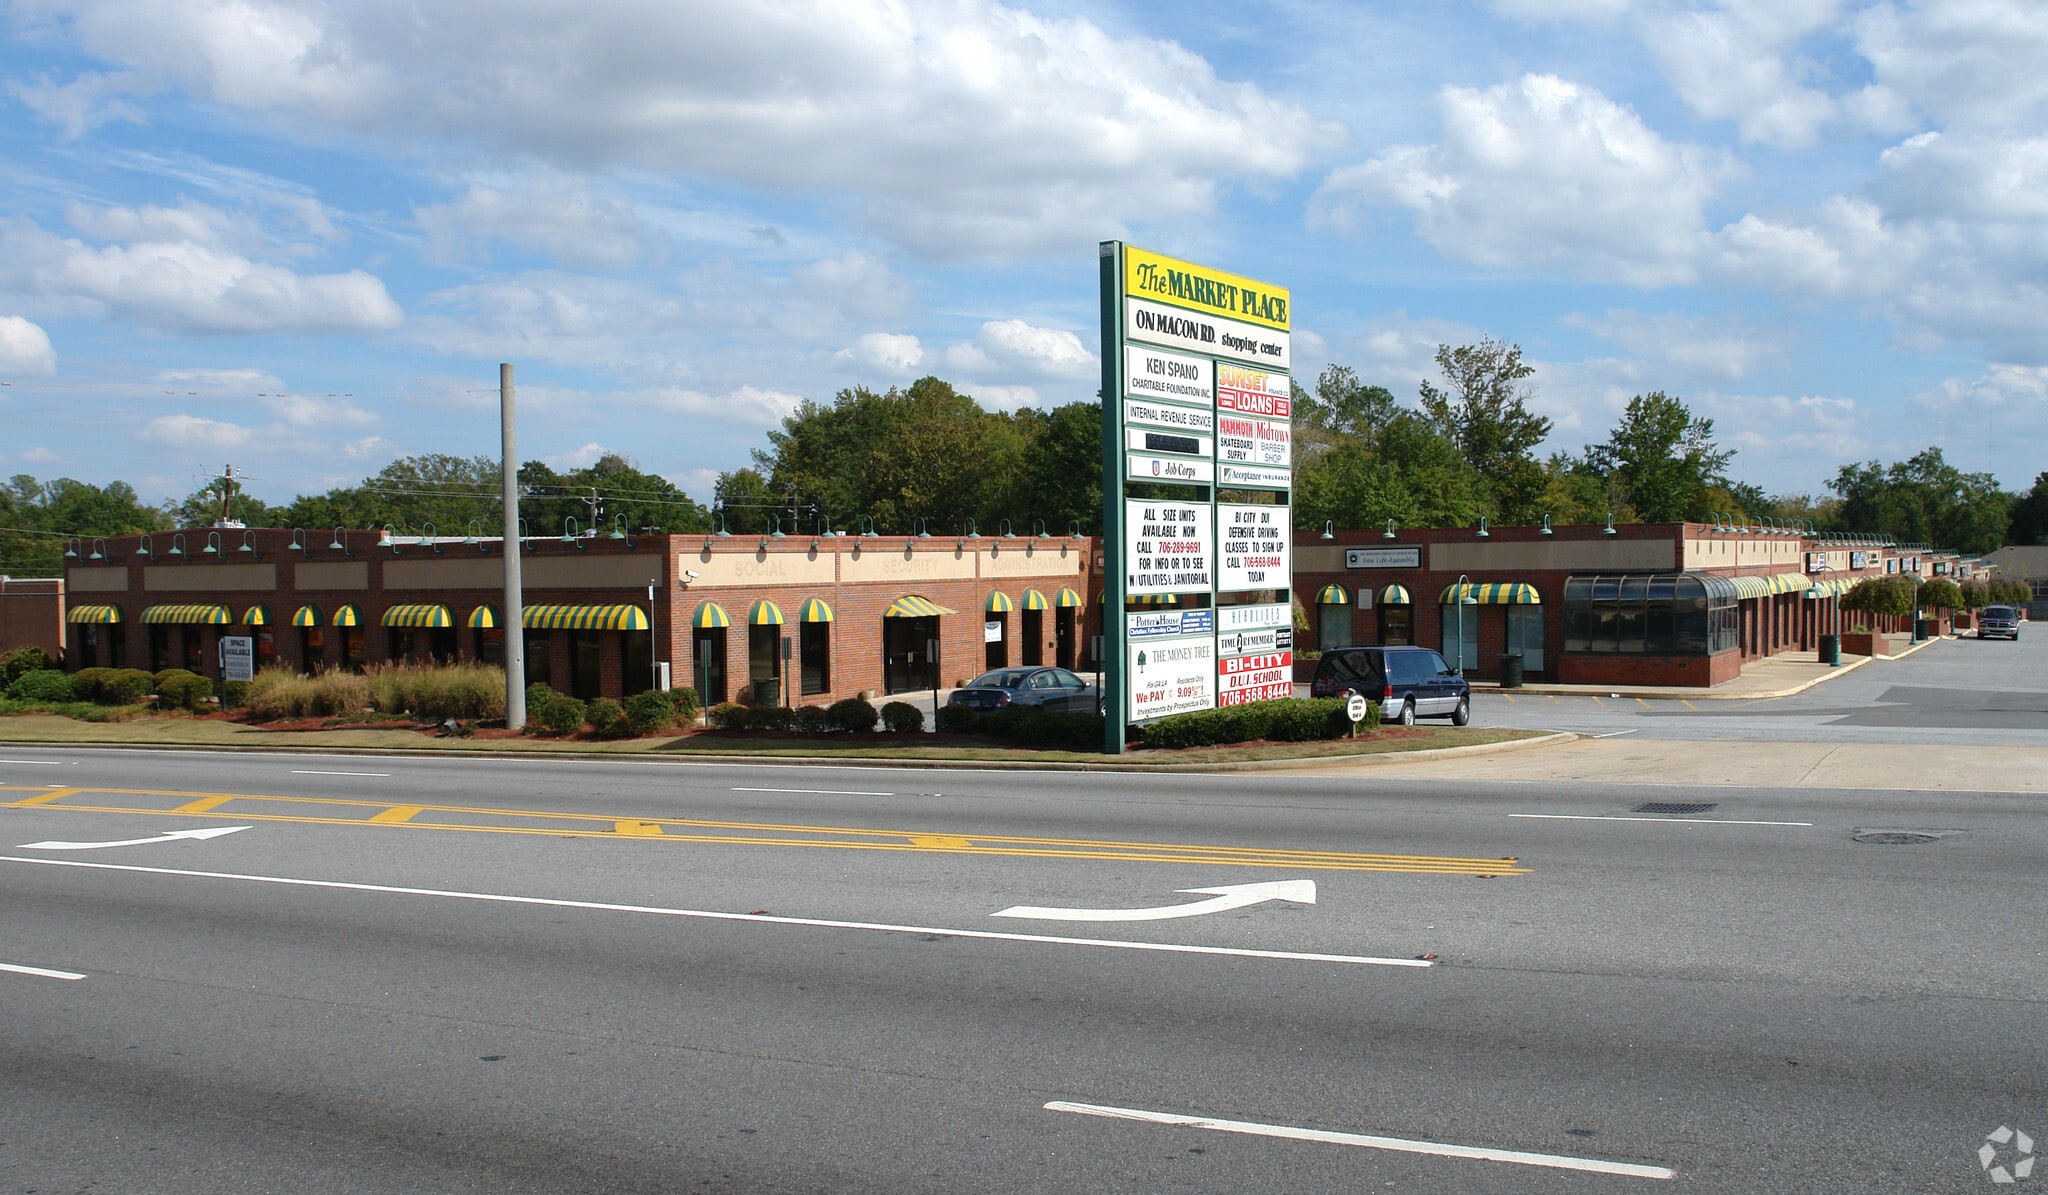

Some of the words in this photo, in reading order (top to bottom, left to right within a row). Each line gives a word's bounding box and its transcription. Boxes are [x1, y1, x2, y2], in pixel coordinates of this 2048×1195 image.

[1137, 263, 1166, 293] The
[1167, 269, 1238, 311] MARKET
[1241, 289, 1287, 323] PLACE
[1136, 310, 1155, 330] ON
[1157, 314, 1198, 340] MACON
[1200, 324, 1216, 344] RD.
[1222, 333, 1257, 355] shopping
[1260, 341, 1282, 357] center
[1147, 358, 1165, 375] KEN
[1168, 361, 1199, 381] SPANO
[1219, 364, 1268, 391] SUNSET
[1132, 378, 1165, 391] CHARITABLE
[1167, 383, 1200, 397] FOUNDATION
[1237, 392, 1273, 414] LOANS
[1130, 406, 1159, 420] INTERNAL
[1161, 410, 1187, 424] REVENUE
[1189, 414, 1211, 427] SERVICE
[1220, 418, 1253, 438] MAMMOTH
[1220, 437, 1253, 450] SKATEBOARD
[1261, 442, 1285, 453] BARBER
[1227, 449, 1246, 460] SUPPLY
[1265, 453, 1281, 463] SHOP
[1165, 462, 1177, 475] Job
[1178, 464, 1196, 479] Corps
[1232, 470, 1261, 481] Acceptance
[1263, 474, 1290, 482] INSURANCE
[1144, 508, 1156, 521] ALL
[1163, 509, 1176, 521] SIZE
[1179, 509, 1196, 522] UNITS
[1235, 512, 1241, 523] BI
[1243, 512, 1256, 523] CITY
[1261, 512, 1270, 523] DUI
[1142, 525, 1176, 537] AVAILABLE
[1183, 526, 1196, 537] NOW
[1229, 526, 1255, 538] DEFENSIVE
[1258, 527, 1278, 538] DRIVING
[1137, 541, 1152, 553] CALL
[1225, 542, 1248, 553] CLASSES
[1252, 542, 1260, 553] TO
[1262, 542, 1274, 553] SIGN
[1276, 542, 1284, 553] UP
[734, 560, 786, 577] SOCIAL
[882, 558, 938, 574] SECURITY
[1139, 557, 1151, 570] FOR
[1155, 558, 1169, 570] INFO
[1171, 558, 1180, 570] OR
[1182, 557, 1190, 569] TO
[1193, 557, 1203, 569] SEE
[1227, 557, 1240, 568] CALL
[1174, 573, 1209, 585] JANITORIAL
[1248, 571, 1265, 583] TODAY
[1160, 614, 1180, 626] House
[1220, 638, 1236, 649] TIME
[1242, 634, 1275, 647] REMEMBER
[1152, 650, 1166, 663] THE
[1168, 647, 1192, 662] MONEY
[1194, 646, 1211, 659] TREE
[1226, 653, 1285, 673] BI-CITY
[1176, 677, 1195, 685] Residents
[1196, 675, 1204, 683] Only
[1253, 670, 1283, 684] SCHOOL
[1136, 693, 1148, 704] We
[1150, 690, 1165, 702] PAY
[1137, 705, 1166, 716] Investments
[1166, 704, 1174, 712] by
[1173, 701, 1199, 711] Prospectus
[1200, 698, 1210, 707] Only
